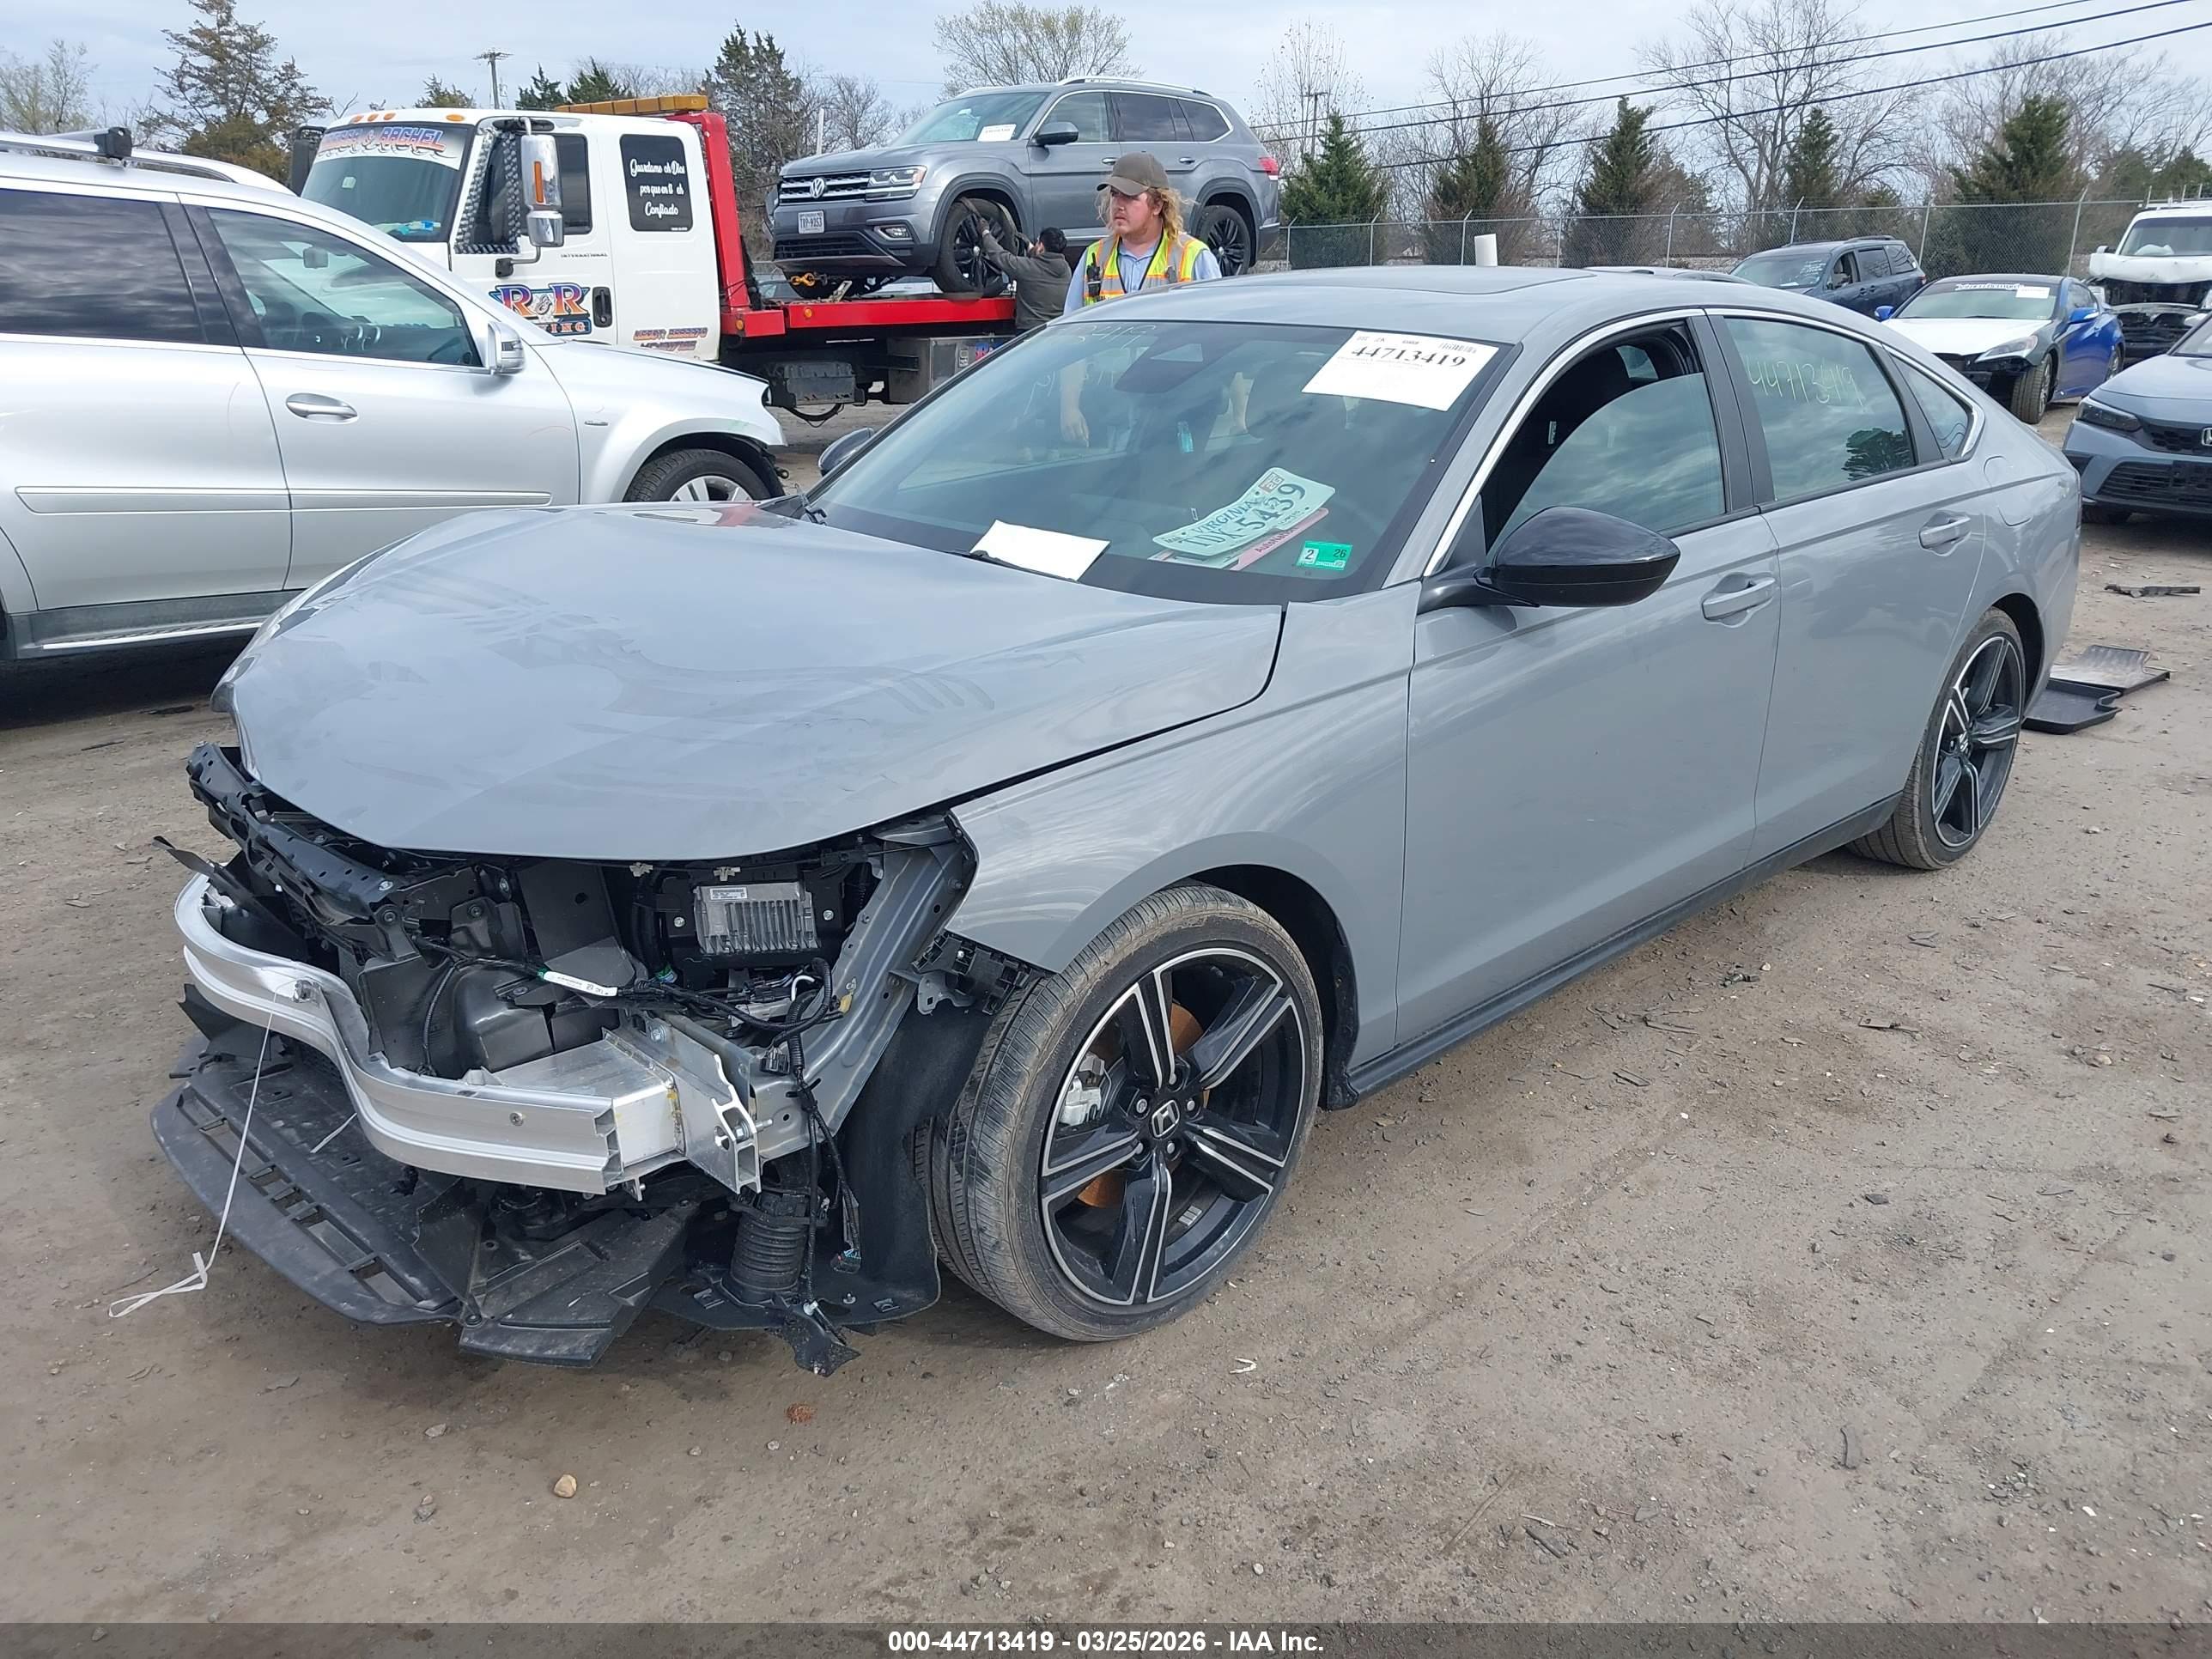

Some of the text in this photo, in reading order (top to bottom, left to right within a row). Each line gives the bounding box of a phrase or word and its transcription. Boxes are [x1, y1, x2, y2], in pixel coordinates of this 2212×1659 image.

[644, 201, 679, 219] Confiado
[496, 284, 537, 317] R
[548, 283, 589, 317] R
[1351, 345, 1467, 368] 44713419
[1192, 500, 1259, 533] VIRGINIA
[1305, 548, 1347, 560] 2 26
